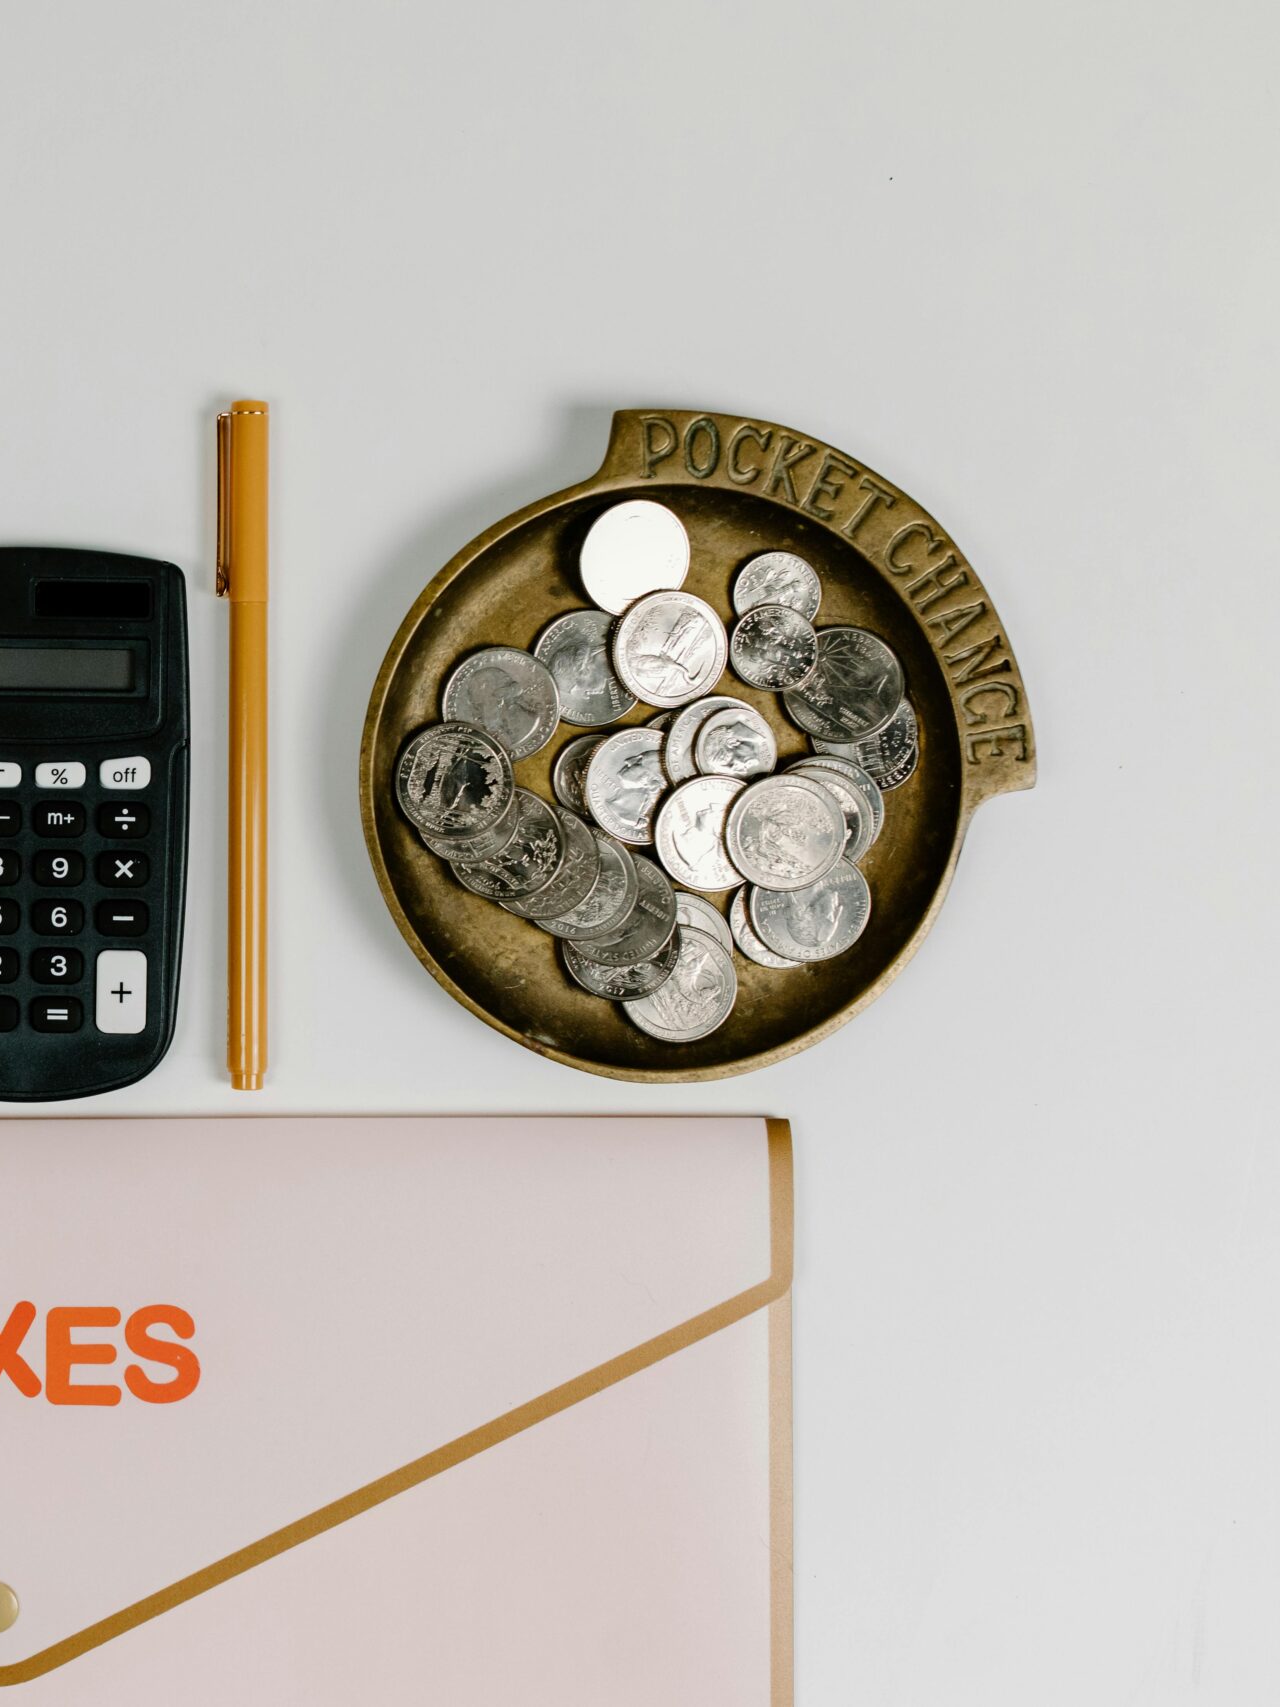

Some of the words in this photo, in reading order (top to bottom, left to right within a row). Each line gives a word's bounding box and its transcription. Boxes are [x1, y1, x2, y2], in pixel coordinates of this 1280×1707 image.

[639, 415, 895, 539] POCKET
[883, 522, 1030, 766] CHANGE
[610, 677, 621, 712] LIBERTY
[609, 732, 639, 752] UNITED
[672, 712, 700, 756] AMERICA
[112, 767, 137, 783] off
[47, 812, 75, 825] m+
[51, 857, 69, 879] 9
[51, 906, 68, 928] 6
[638, 897, 670, 922] LIBERTY
[549, 919, 577, 936] 2016
[50, 955, 67, 977] 3
